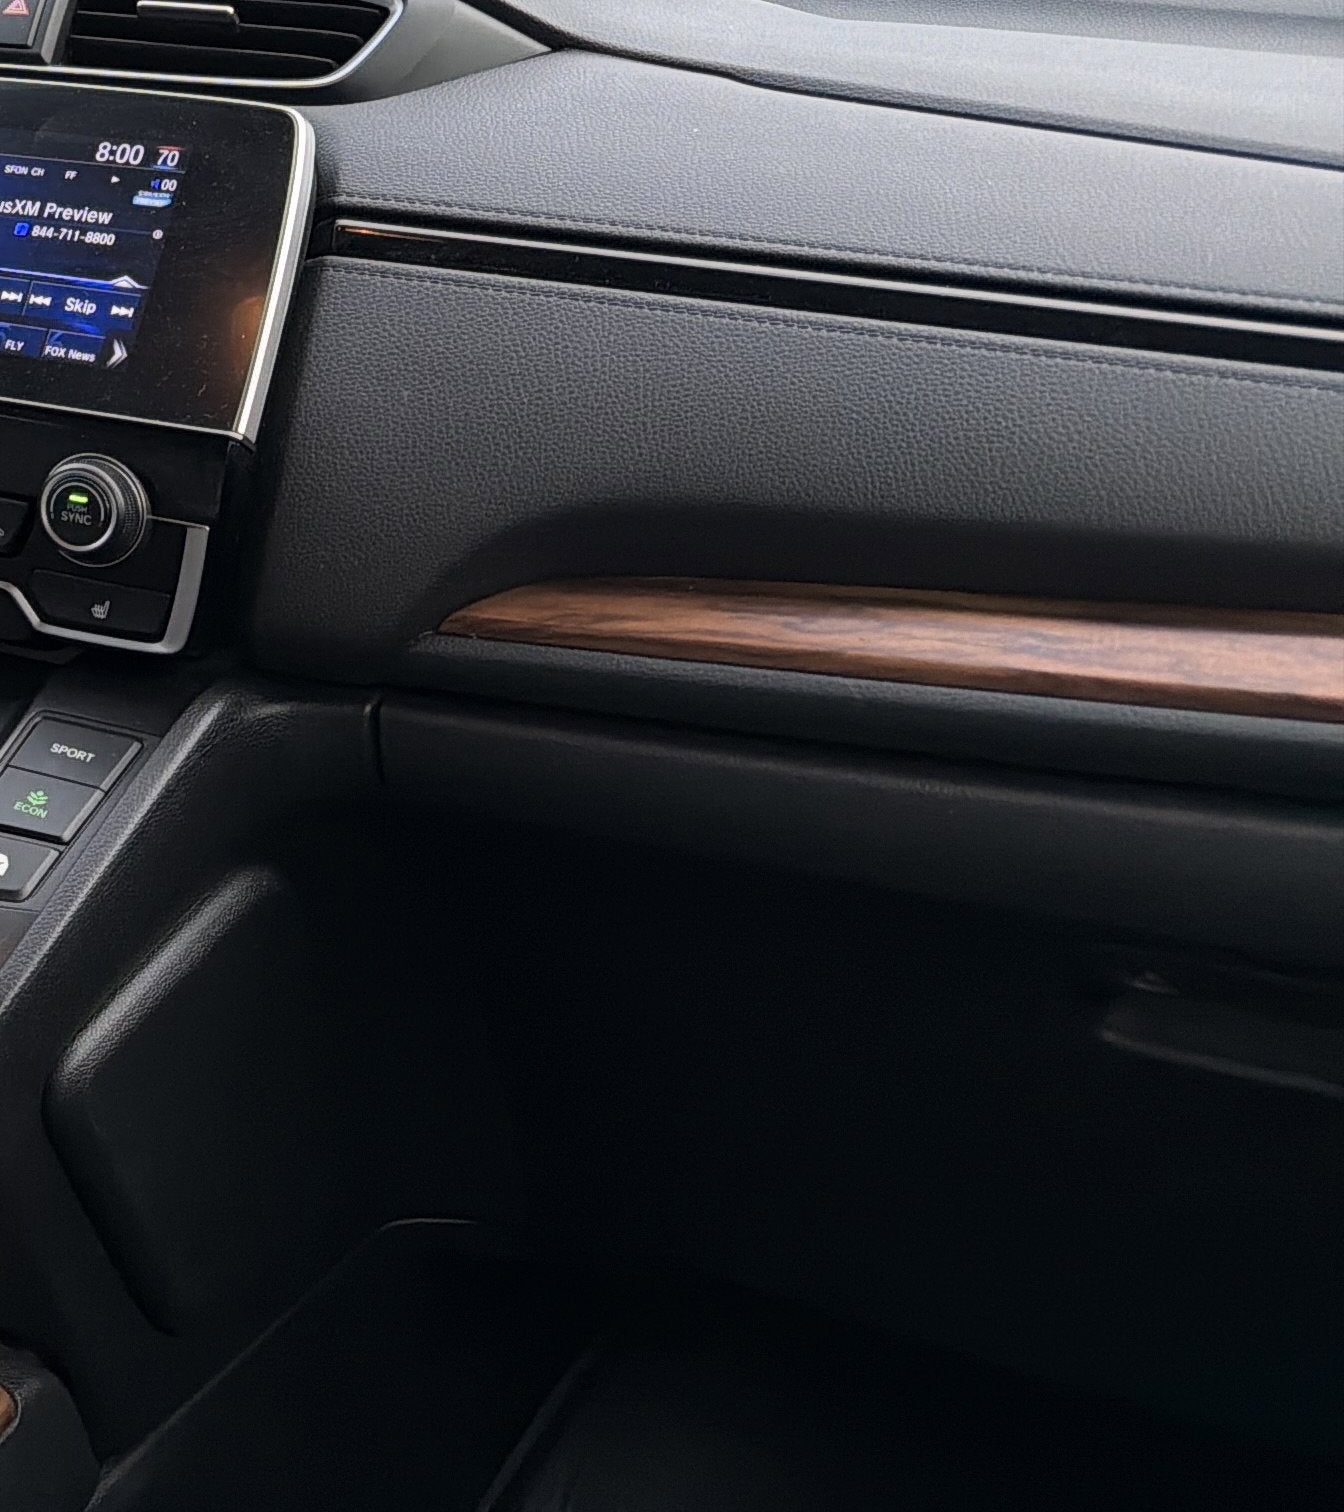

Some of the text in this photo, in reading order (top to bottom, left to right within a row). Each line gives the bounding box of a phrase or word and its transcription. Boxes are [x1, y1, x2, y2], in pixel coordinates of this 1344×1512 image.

[95, 141, 145, 166] 8:00
[157, 150, 180, 166] 70
[160, 179, 178, 191] 00
[43, 202, 114, 225] Preview
[31, 225, 116, 246] 844-711-8800
[64, 297, 97, 316] Skip
[4, 339, 25, 352] FLY
[44, 345, 96, 363] FOX News
[67, 504, 88, 513] PUSH
[61, 511, 92, 526] SYNC
[50, 743, 96, 763] SPORT
[13, 801, 49, 819] ECON
